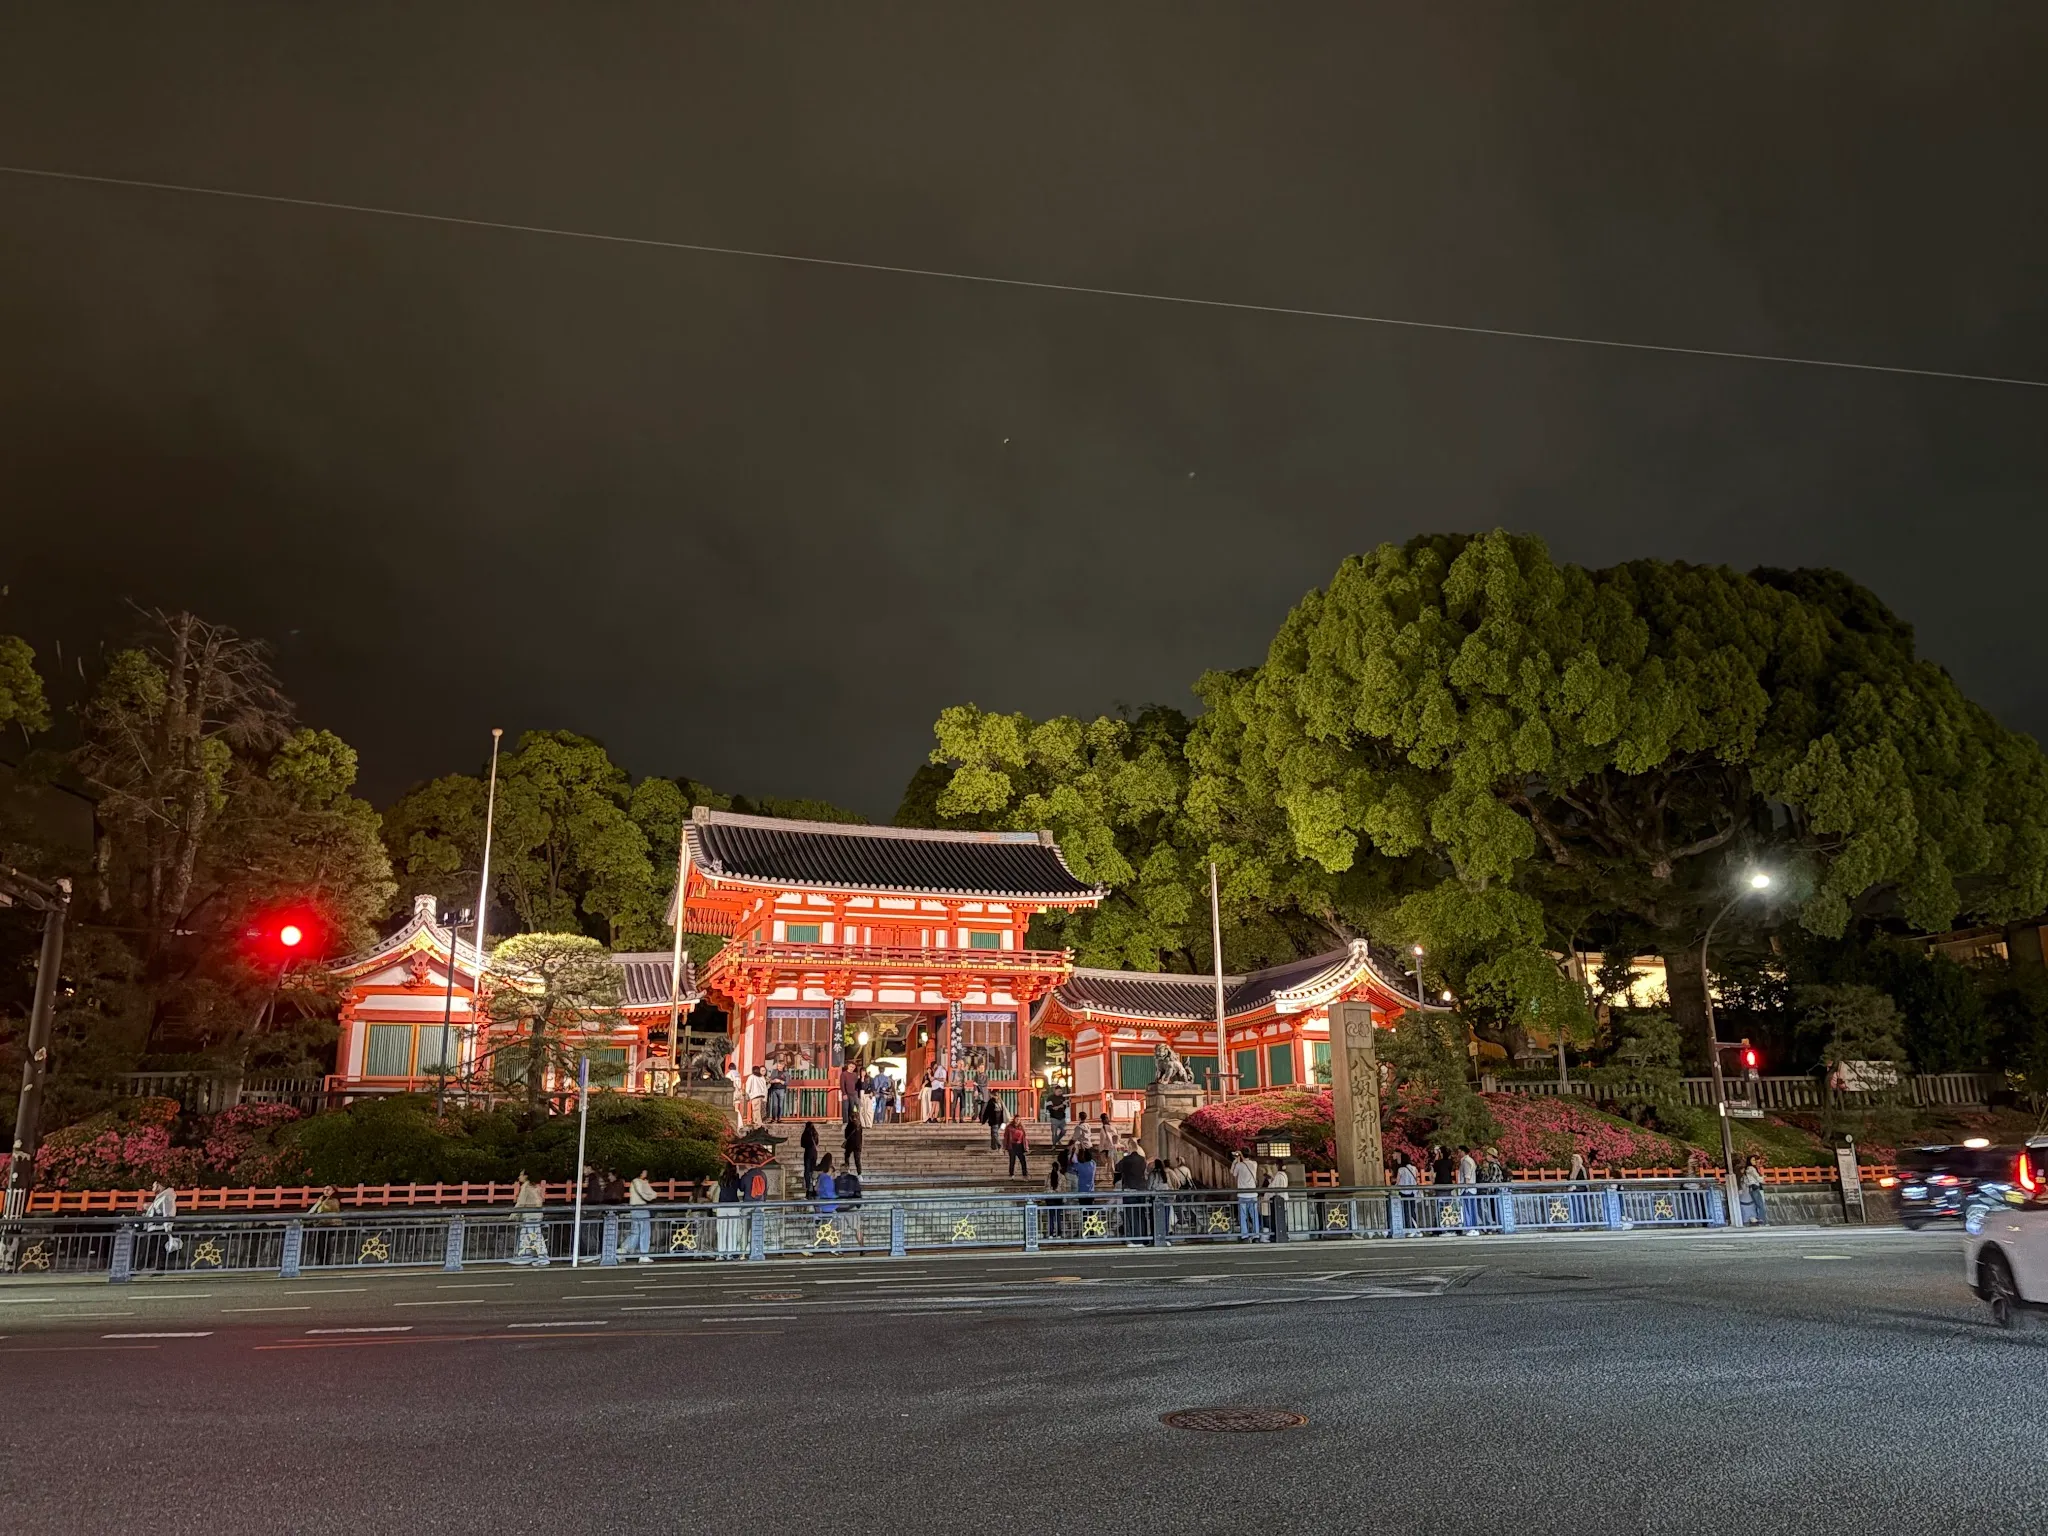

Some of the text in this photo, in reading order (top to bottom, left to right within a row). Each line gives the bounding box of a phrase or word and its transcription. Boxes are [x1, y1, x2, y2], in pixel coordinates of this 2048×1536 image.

[833, 1021, 843, 1053] 月次祭
[1350, 1055, 1380, 1165] 八坂神社
